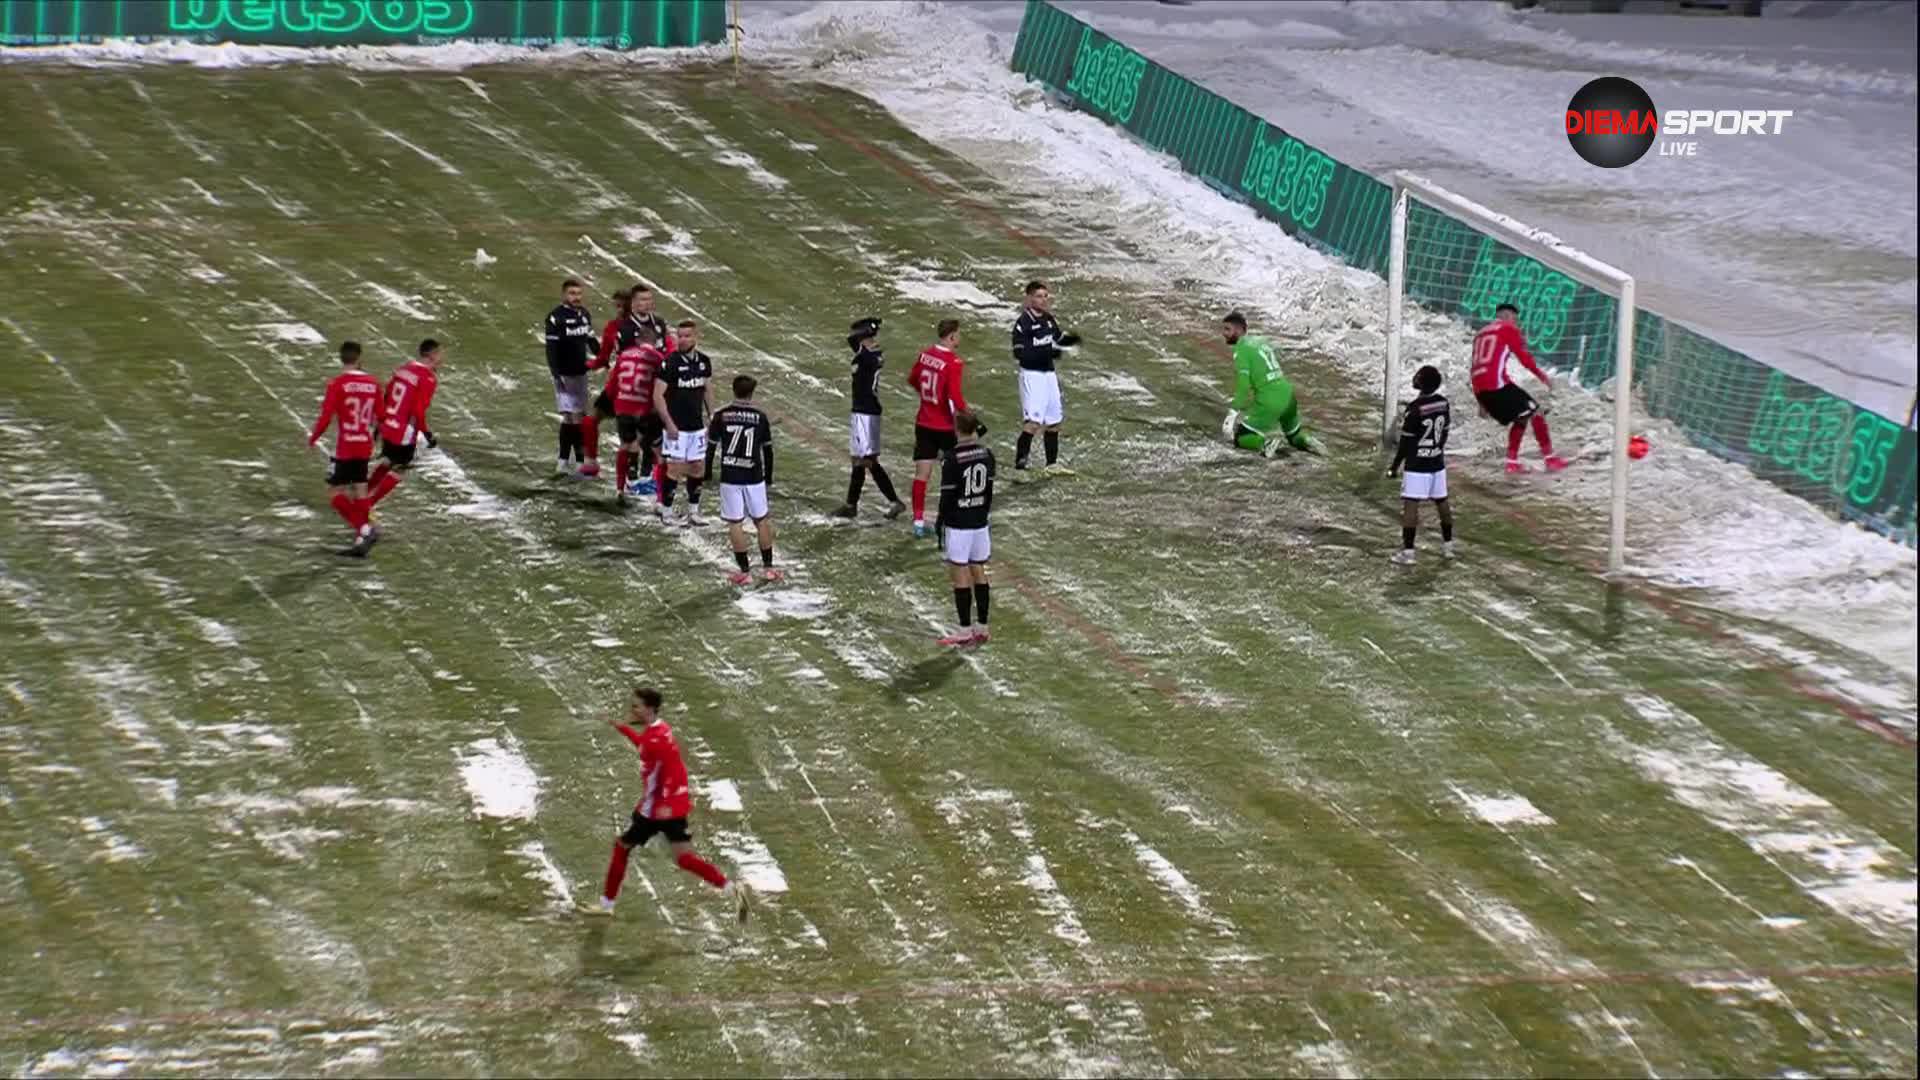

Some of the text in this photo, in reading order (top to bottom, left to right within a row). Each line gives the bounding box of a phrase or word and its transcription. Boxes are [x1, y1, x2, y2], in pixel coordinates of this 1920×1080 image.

[1067, 26, 1146, 123] bet365
[1241, 118, 1336, 229] bet365
[1473, 333, 1498, 366] 10
[618, 360, 652, 393] 22
[920, 369, 939, 405] 21
[344, 396, 375, 432] 34
[386, 381, 407, 415] 9
[726, 425, 755, 457] 71
[1749, 367, 1900, 504] bet365
[962, 463, 988, 497] 10
